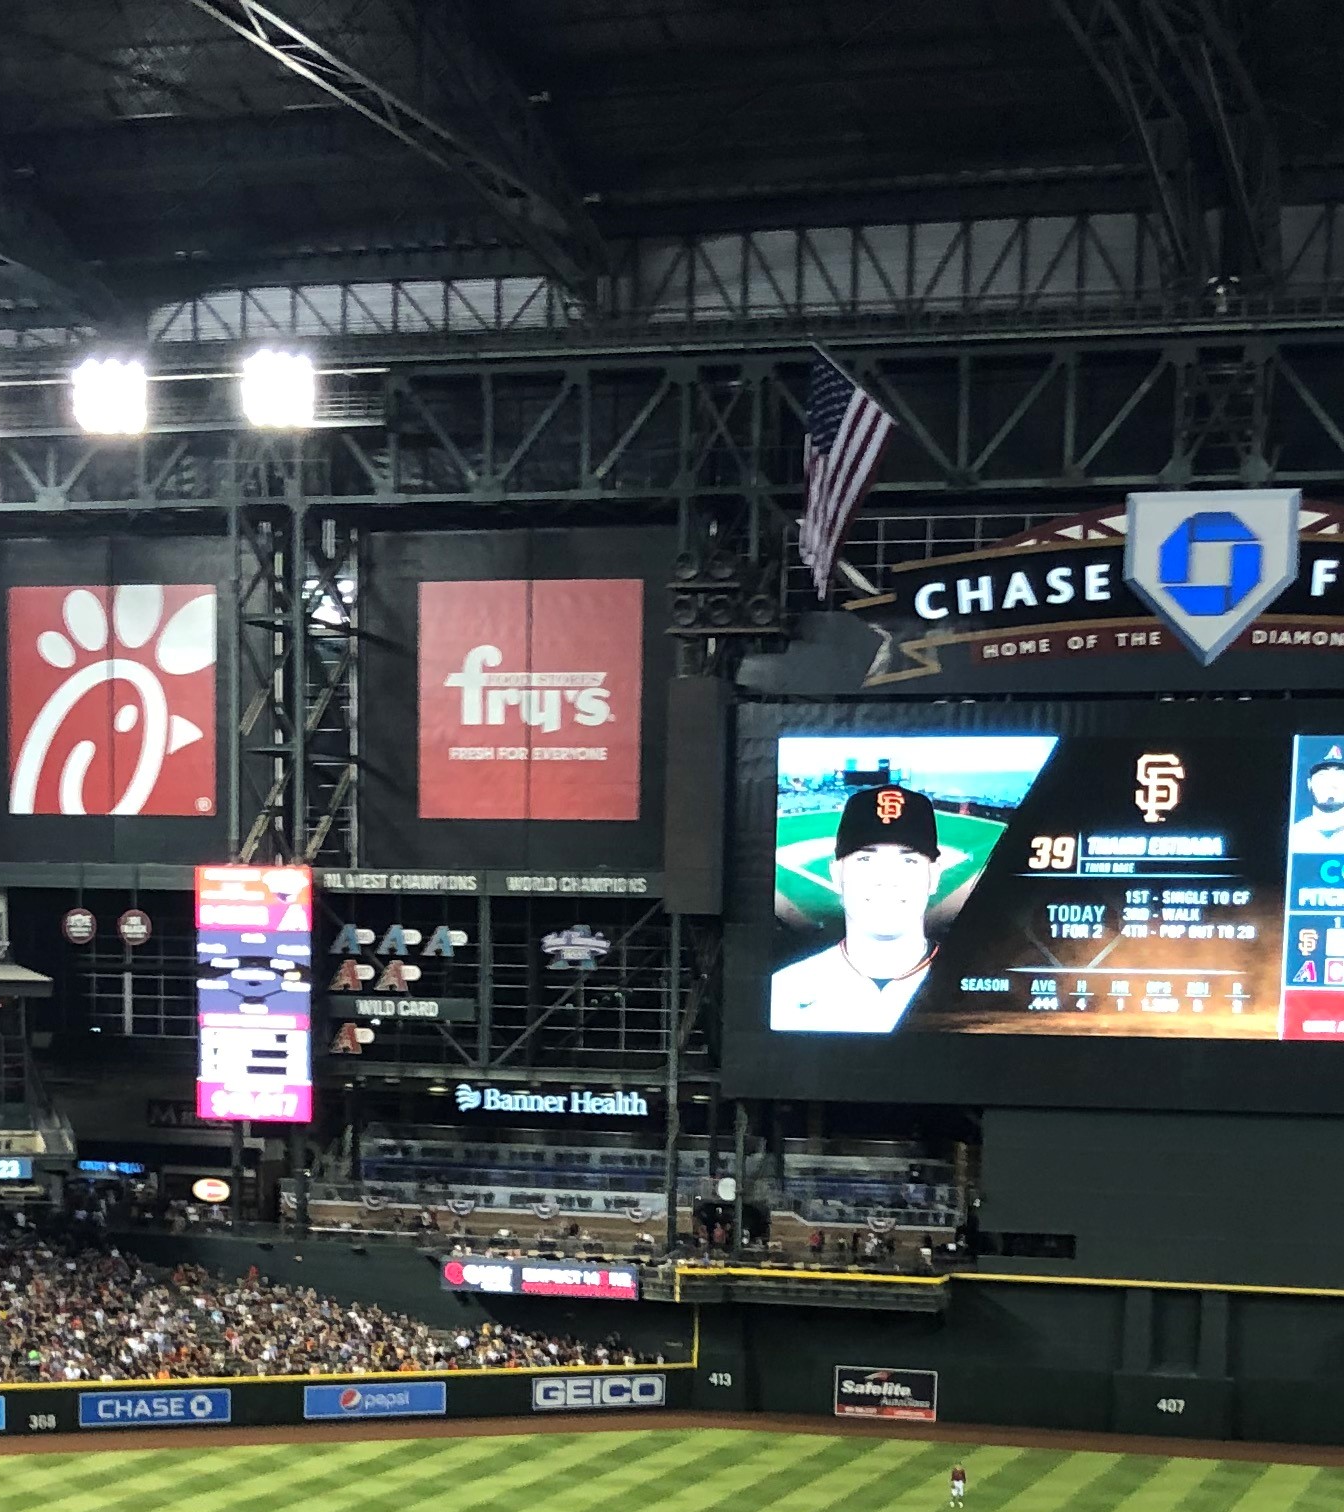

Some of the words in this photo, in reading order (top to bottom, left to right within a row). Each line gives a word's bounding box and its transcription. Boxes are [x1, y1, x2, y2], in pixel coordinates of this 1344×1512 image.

[914, 563, 1111, 620] CHASE
[982, 638, 1051, 659] HOME
[1067, 635, 1099, 651] OF
[1115, 631, 1162, 647] THE
[537, 673, 602, 685] STORES
[444, 645, 612, 733] fry's
[497, 747, 529, 760] FOR
[531, 747, 609, 760] EVERYONE
[1028, 836, 1076, 870] 39
[351, 874, 389, 889] WEST
[390, 875, 477, 891] CHAMPIONS
[506, 876, 557, 892] WORLD
[1047, 904, 1105, 923] TODAY
[960, 978, 1009, 991] SEASON
[1031, 979, 1056, 992] AVG
[356, 1000, 395, 1016] WILD
[397, 1001, 439, 1017] CARD
[483, 1088, 567, 1113] Banner
[570, 1091, 649, 1116] Health
[709, 1372, 732, 1386] 413
[841, 1379, 912, 1397] Safelite
[535, 1376, 663, 1406] GEICO
[97, 1397, 186, 1419] CHASE
[364, 1391, 410, 1410] pepsi
[1156, 1398, 1185, 1414] 407
